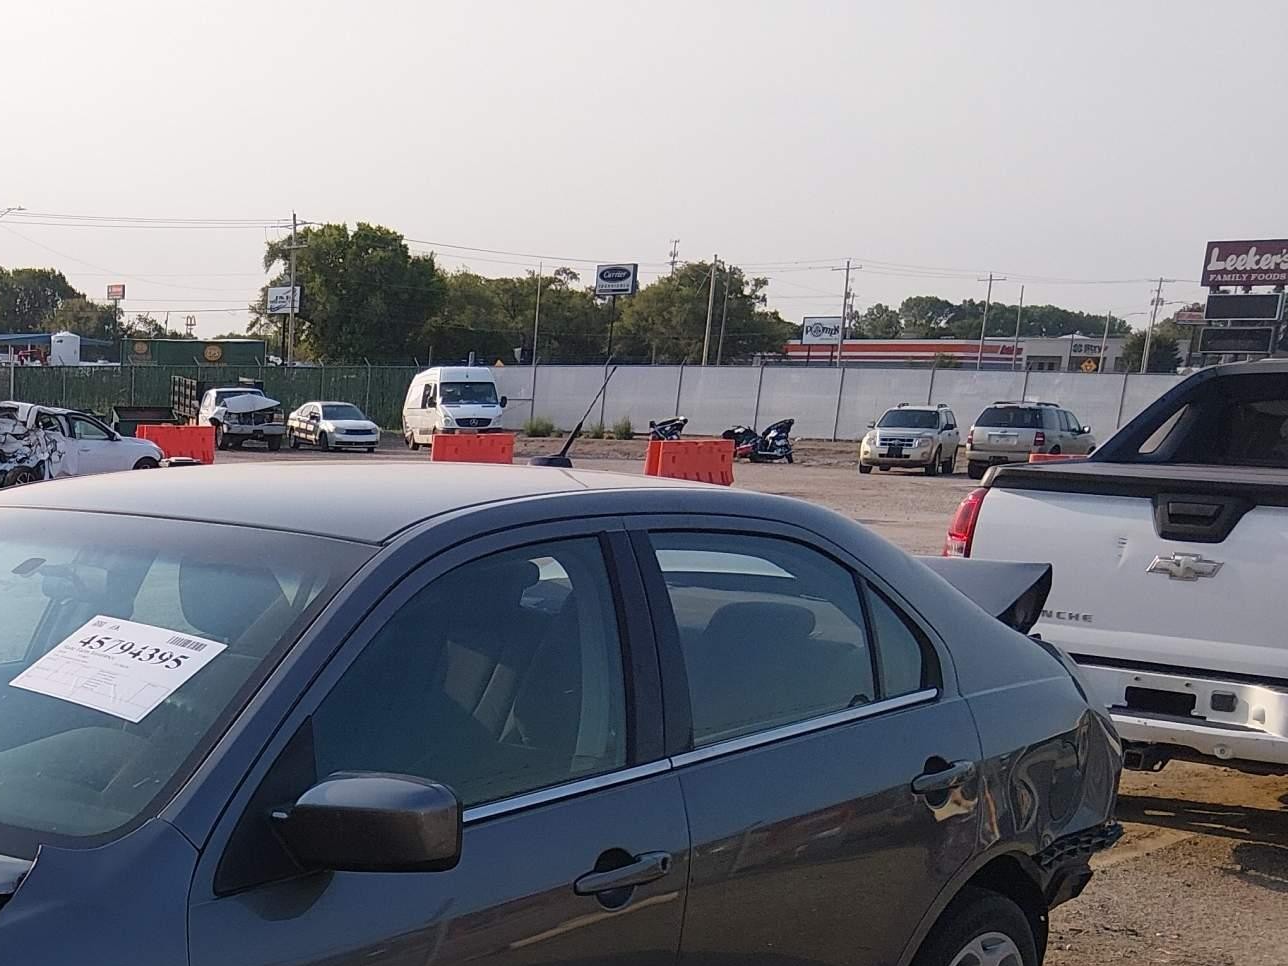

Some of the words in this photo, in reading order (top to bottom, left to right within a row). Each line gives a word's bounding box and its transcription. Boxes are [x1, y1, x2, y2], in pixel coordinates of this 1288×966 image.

[1207, 246, 1288, 271] Leeker's
[1209, 273, 1249, 281] FAMILY
[1251, 272, 1287, 281] FOODS
[79, 634, 191, 670] 45794395
